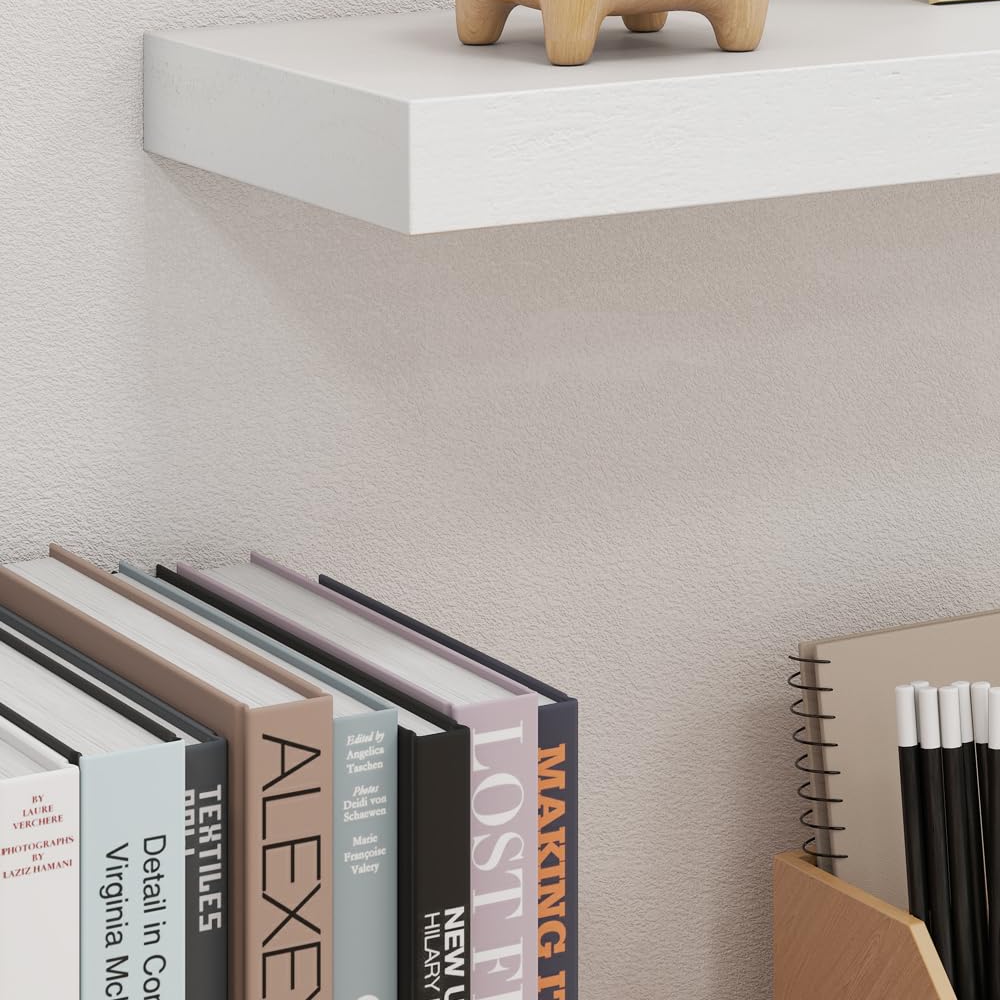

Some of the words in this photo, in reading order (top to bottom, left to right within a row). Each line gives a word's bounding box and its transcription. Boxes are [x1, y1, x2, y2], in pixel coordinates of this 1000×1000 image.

[346, 731, 374, 746] Edited
[375, 730, 385, 743] by
[346, 746, 385, 761] Angelica
[346, 760, 384, 774] Taschen
[32, 794, 44, 804] BY
[352, 784, 379, 797] Photos
[369, 795, 387, 805] von
[22, 804, 54, 817] LAURE
[472, 720, 525, 919] LOST
[13, 815, 63, 830] VERCHERE
[1, 836, 75, 856] PHOTOGRAPHS
[352, 832, 378, 847] Marie
[32, 853, 44, 862] BY
[199, 784, 222, 932] TEXTILES
[344, 846, 387, 863] Françoise
[538, 743, 567, 959] MAKING
[3, 866, 31, 879] LAZIZ
[33, 859, 73, 874] HAMANI
[143, 834, 167, 914] Detail
[262, 733, 321, 1000] ALEXE
[351, 861, 380, 875] Valery
[99, 842, 129, 949] Virginia
[143, 921, 167, 946] in
[444, 905, 465, 977] NEW
[424, 911, 441, 992] HILARY
[105, 955, 129, 1000] Mc
